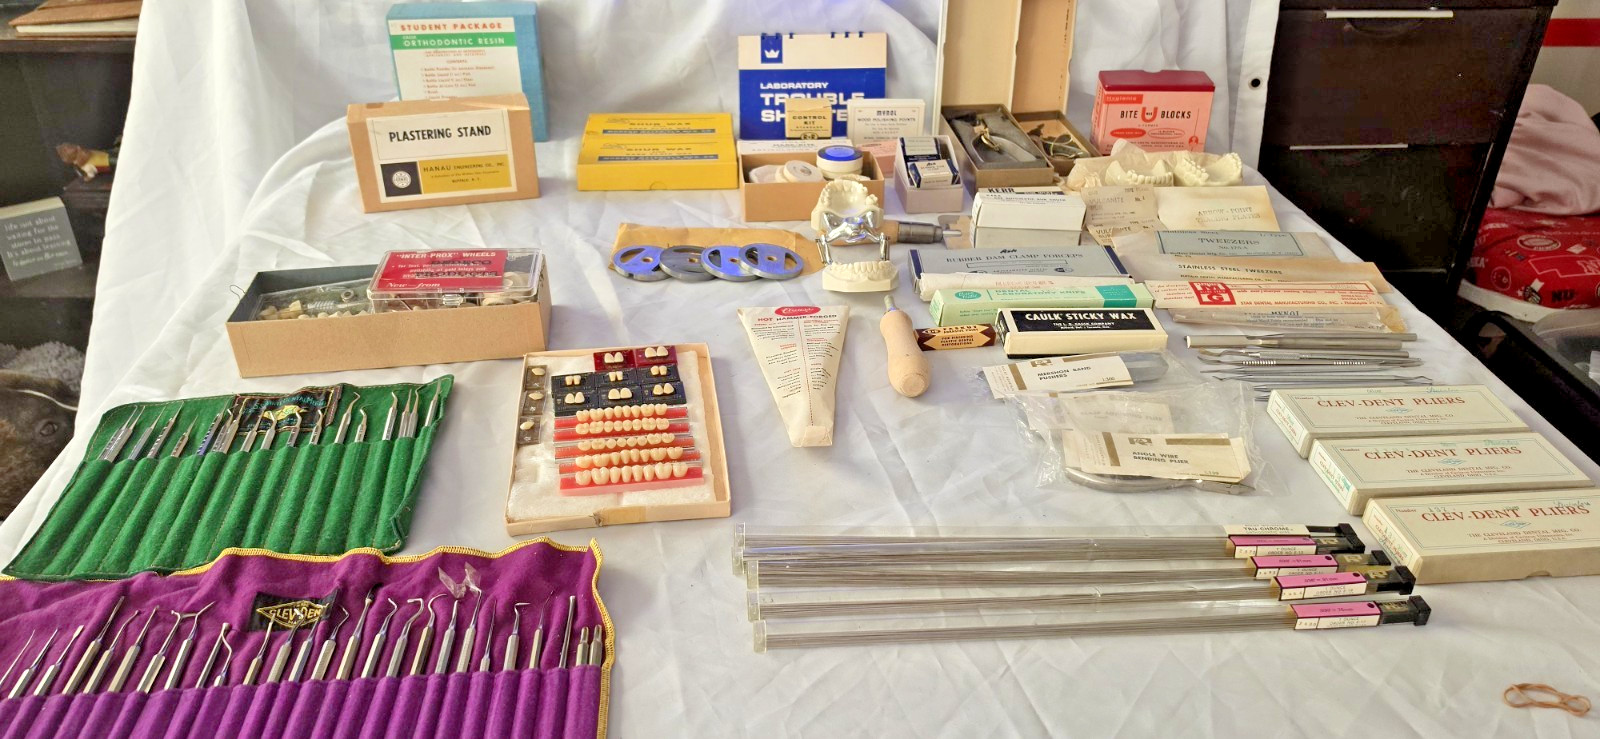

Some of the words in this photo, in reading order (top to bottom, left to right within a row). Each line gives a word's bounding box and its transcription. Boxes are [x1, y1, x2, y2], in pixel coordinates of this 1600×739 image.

[401, 23, 448, 32] STUDENT
[453, 22, 502, 30] PACKAGE
[403, 37, 473, 47] ORTHODONTIC
[478, 37, 505, 45] RESIN
[760, 82, 829, 90] LABORATORY
[1120, 110, 1139, 119] BITE
[1160, 110, 1192, 119] BLOCKS
[389, 128, 452, 143] PLASTERING
[457, 126, 492, 138] STAND
[423, 165, 452, 173] HANAU
[1197, 237, 1260, 245] TWEEZERS
[1025, 313, 1061, 321] CAULK
[1065, 312, 1105, 320] STICKY
[1109, 312, 1137, 320] WAX
[1037, 369, 1070, 377] MERSHON
[1039, 373, 1068, 381] PUSHERS
[1317, 398, 1406, 408] CLEV-DENT
[1412, 396, 1466, 406] PLIERS
[1364, 449, 1458, 460] CLEV-DENT
[1465, 446, 1522, 456] PLIERS
[1421, 509, 1522, 522] CLEV-DENT
[1528, 505, 1591, 517] PLIERS
